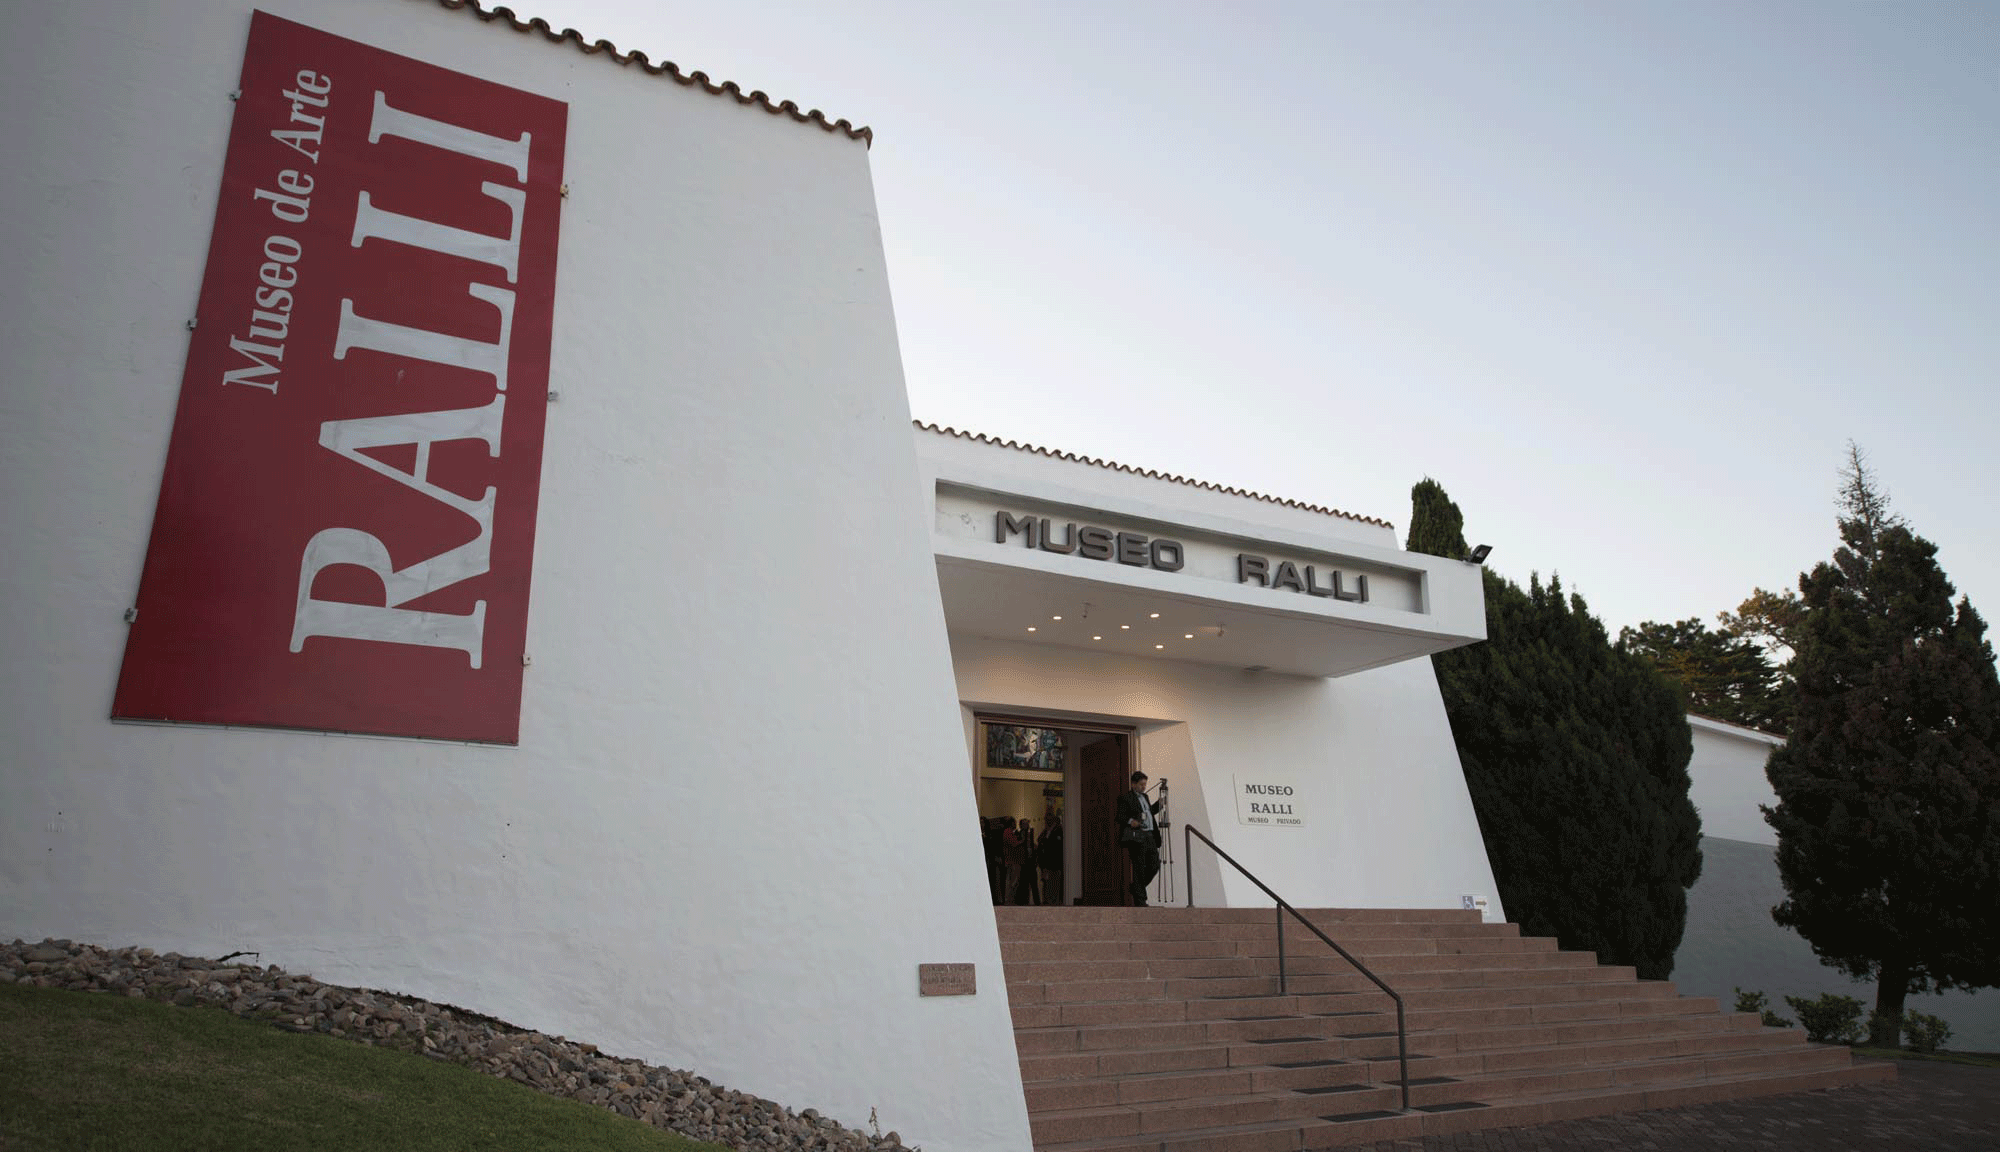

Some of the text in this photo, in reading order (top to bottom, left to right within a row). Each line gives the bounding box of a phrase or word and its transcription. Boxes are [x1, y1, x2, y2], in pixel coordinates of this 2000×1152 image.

[222, 68, 332, 394] Museo de Arte
[289, 90, 532, 670] RALLI
[996, 510, 1370, 603] MUSEO RALLI
[1245, 784, 1293, 796] MUSEO
[1251, 803, 1292, 815] RALLI
